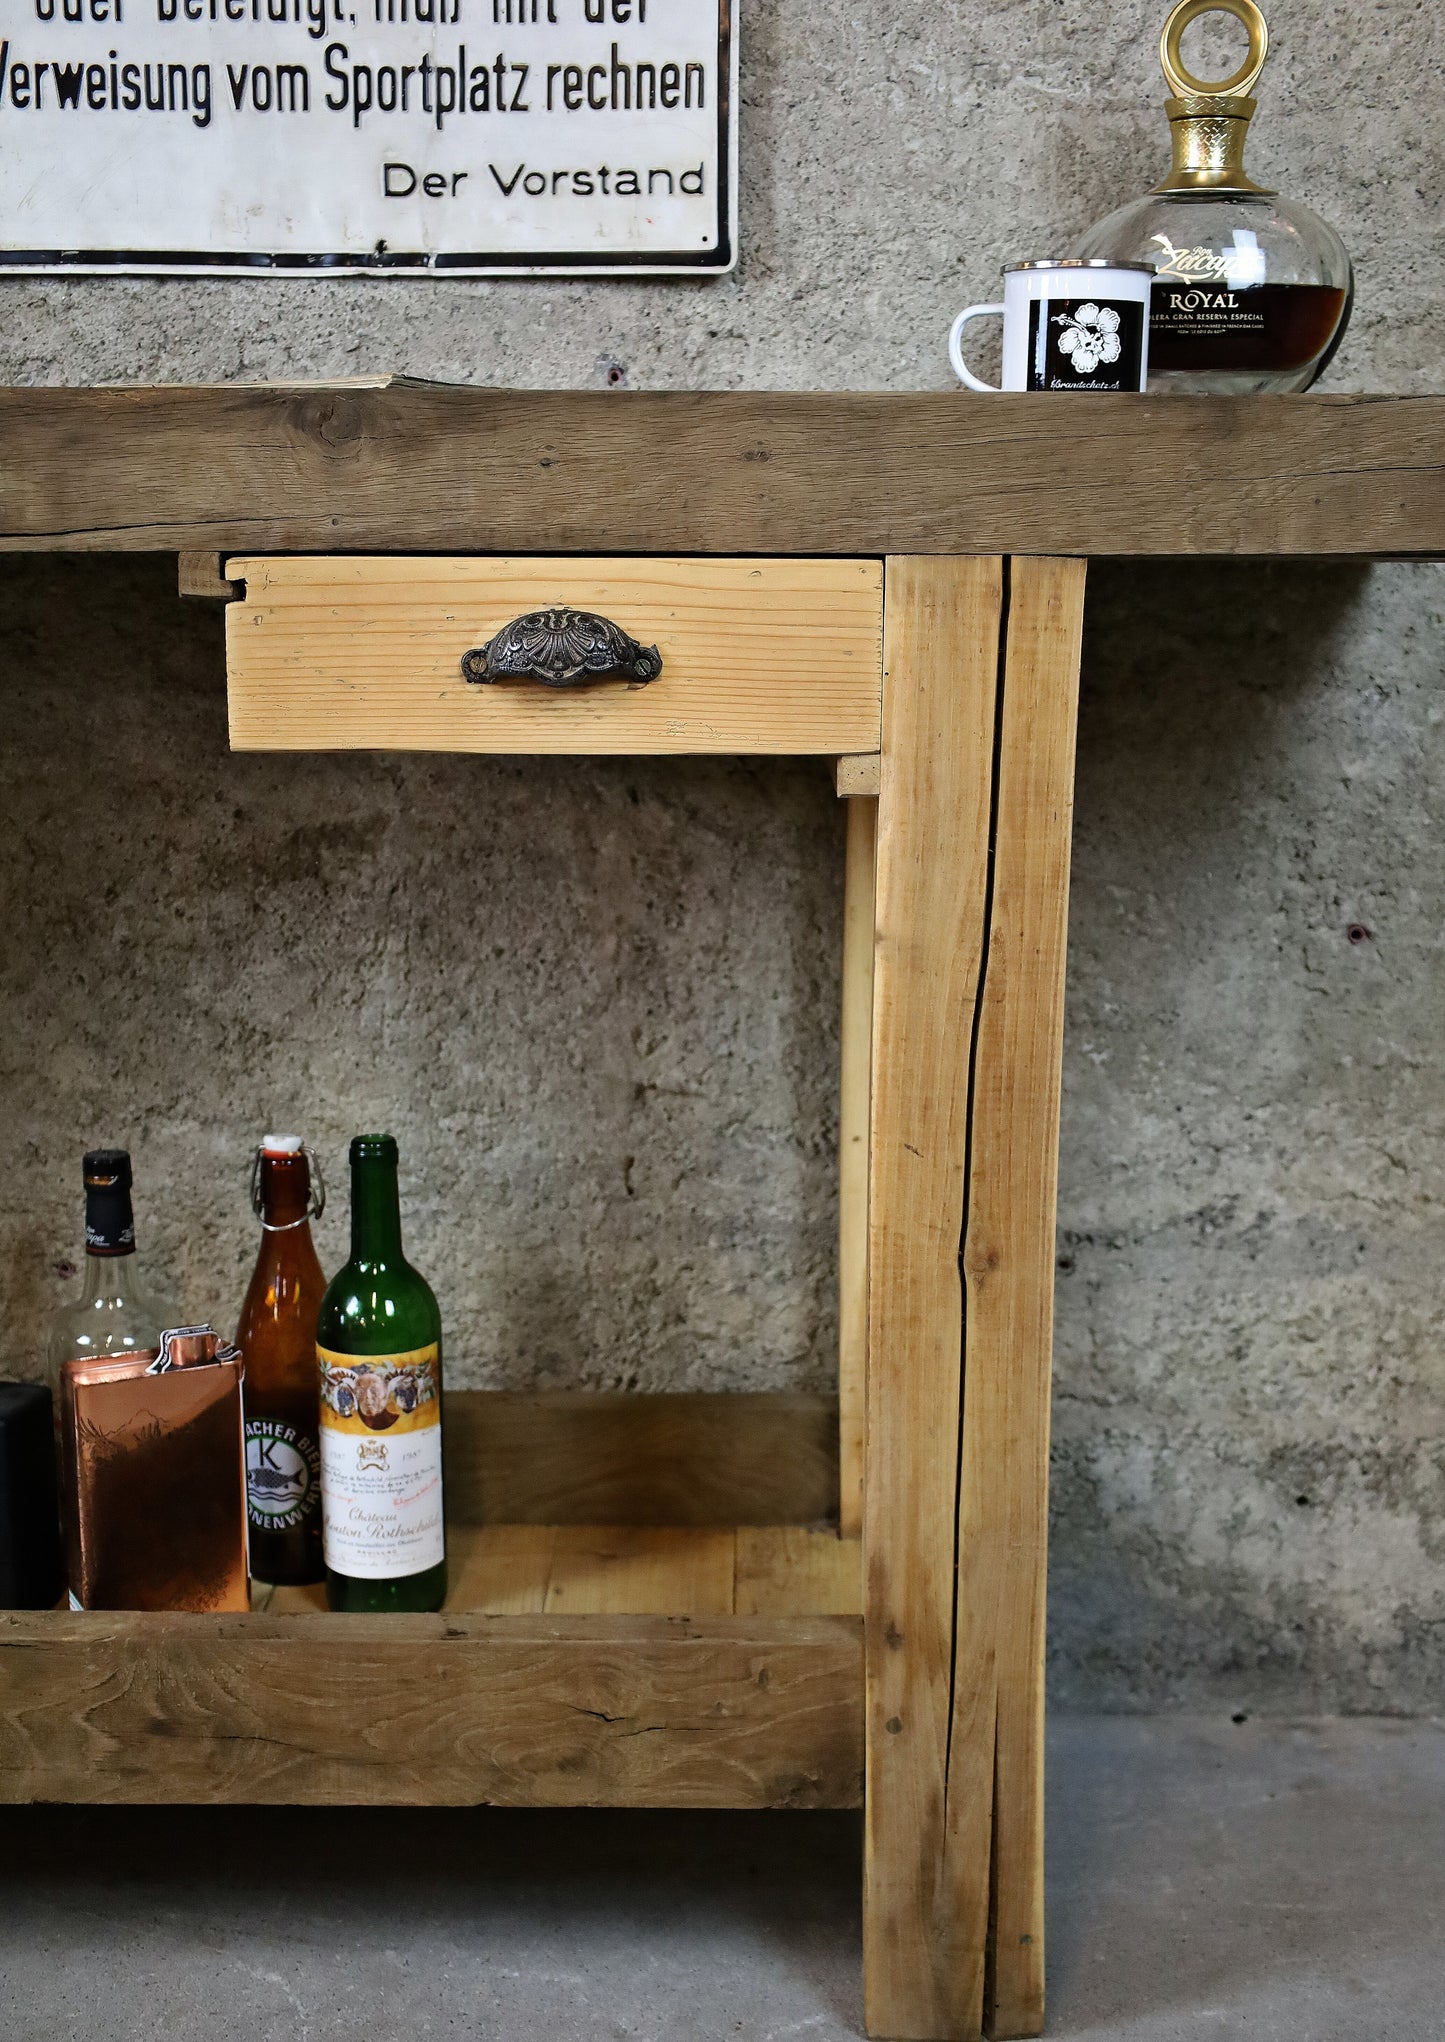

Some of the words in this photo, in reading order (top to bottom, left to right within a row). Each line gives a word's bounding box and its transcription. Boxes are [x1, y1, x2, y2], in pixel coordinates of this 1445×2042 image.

[227, 64, 309, 112] vom
[324, 42, 530, 130] Sportplatz
[547, 42, 706, 111] rechnen
[383, 162, 468, 198] Der
[488, 161, 705, 197] Vorstand
[1190, 246, 1213, 256] Ron
[1169, 290, 1239, 312] ROYAL
[1196, 313, 1229, 321] RESERVA
[1230, 313, 1264, 321] ESPECIAL
[258, 1439, 283, 1470] K
